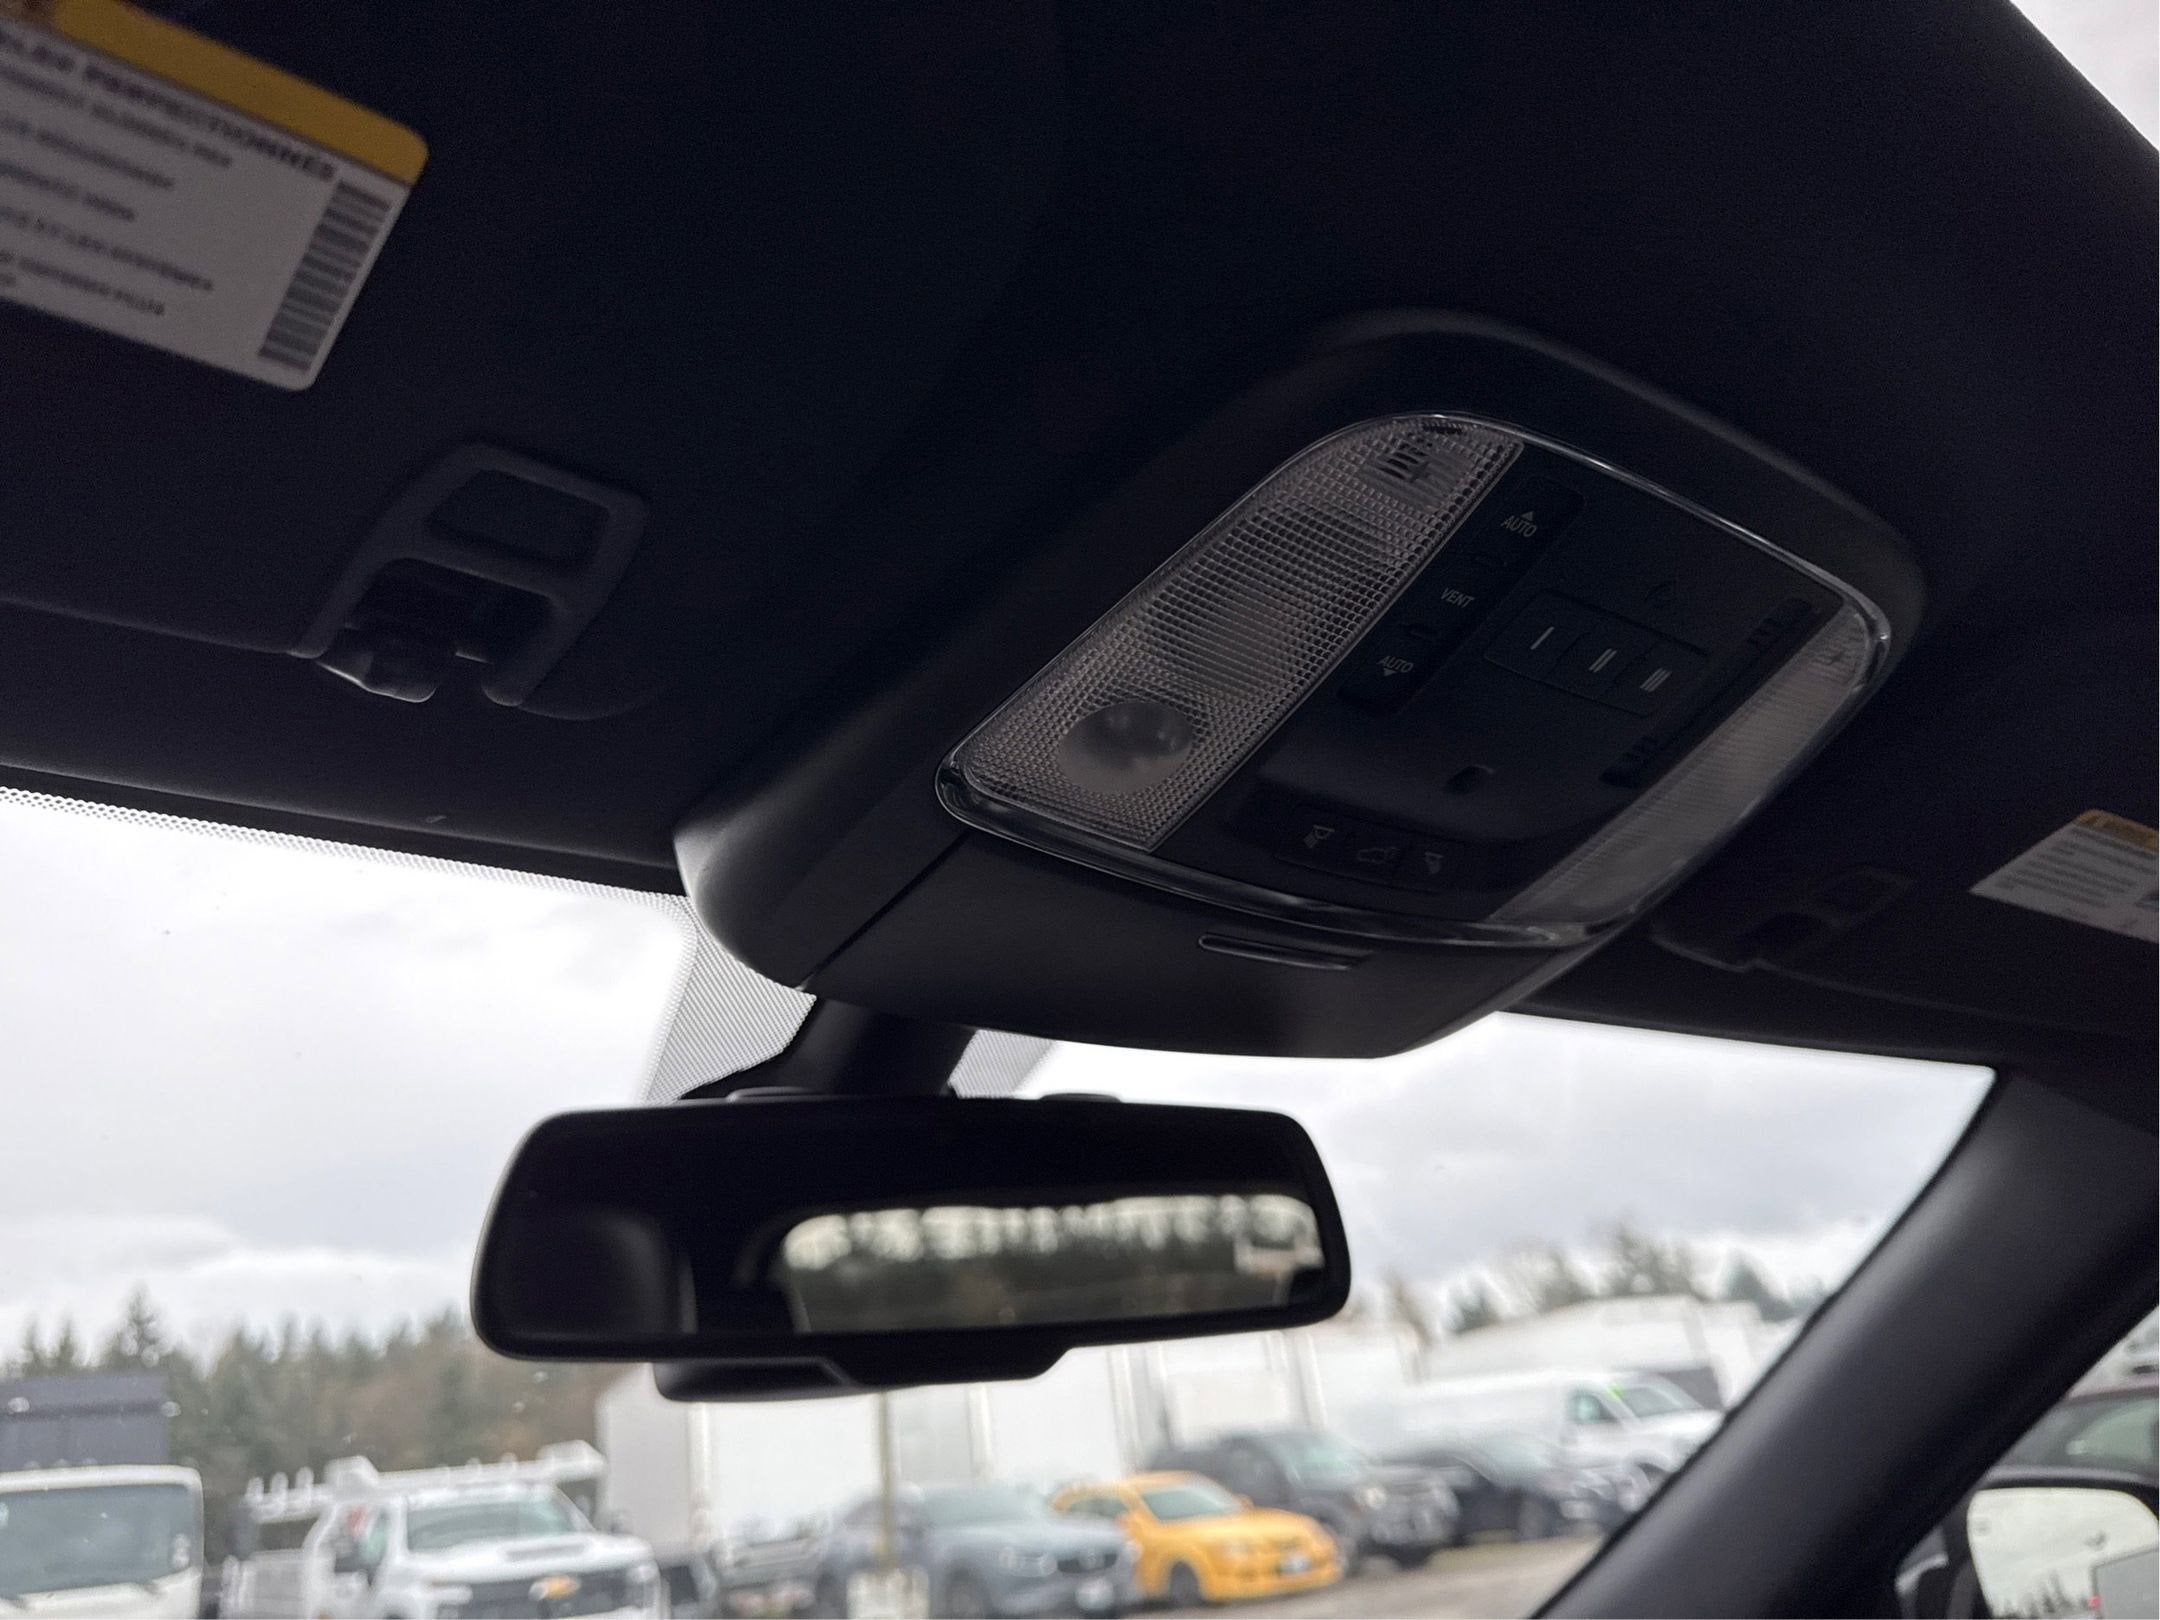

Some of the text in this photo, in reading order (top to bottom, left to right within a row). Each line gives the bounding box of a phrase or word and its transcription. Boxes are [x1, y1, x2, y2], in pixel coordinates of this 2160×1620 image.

[1500, 515, 1538, 538] AUTO
[1440, 587, 1476, 608] VENT
[1376, 655, 1415, 674] AUTO
